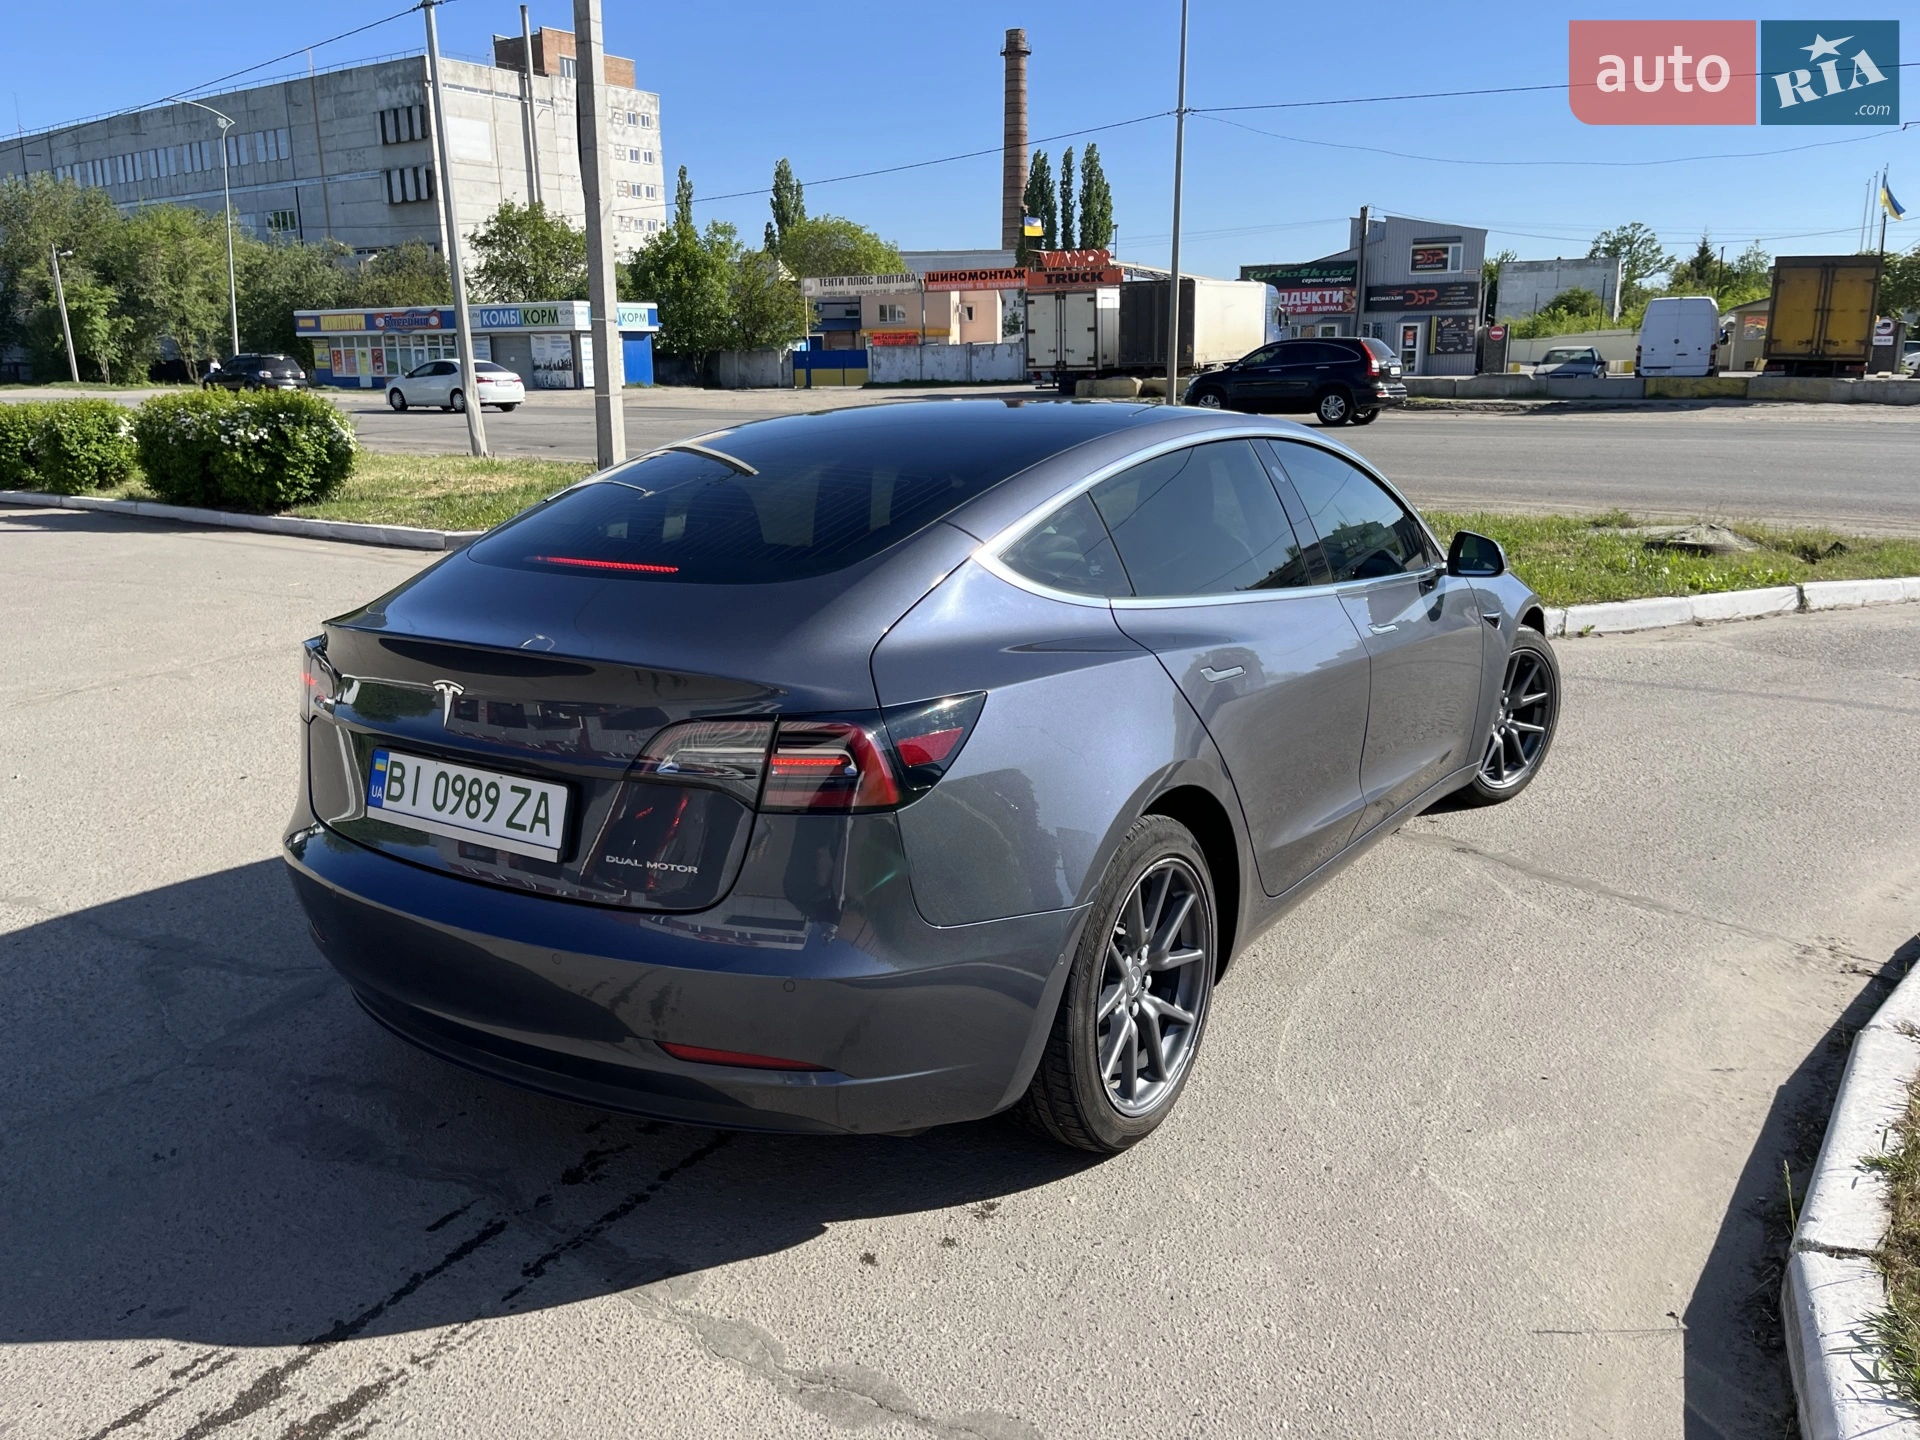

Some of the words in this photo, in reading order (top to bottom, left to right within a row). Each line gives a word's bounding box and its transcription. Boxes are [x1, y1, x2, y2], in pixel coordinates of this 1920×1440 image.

[819, 278, 845, 287] ТЕНТИ
[847, 276, 874, 286] ПЛЮС
[877, 273, 917, 285] ПОЛТАВА
[928, 269, 1026, 282] ШИНОМОНТАЖ
[1045, 271, 1104, 284] TRUCK
[928, 281, 973, 290] ВАНТАЖНИЙ
[987, 279, 1026, 289] ЛЕГКОВИЙ
[1279, 290, 1344, 306] ОДУКТИ
[482, 309, 520, 326] КОМБІ
[523, 307, 559, 325] КОРМ
[622, 312, 647, 323] КОРМ
[371, 785, 383, 799] UA
[385, 760, 421, 806] BI
[433, 771, 501, 823] 0989
[506, 785, 550, 837] ZA
[605, 855, 643, 868] DUAL
[647, 860, 698, 874] MOTOR
